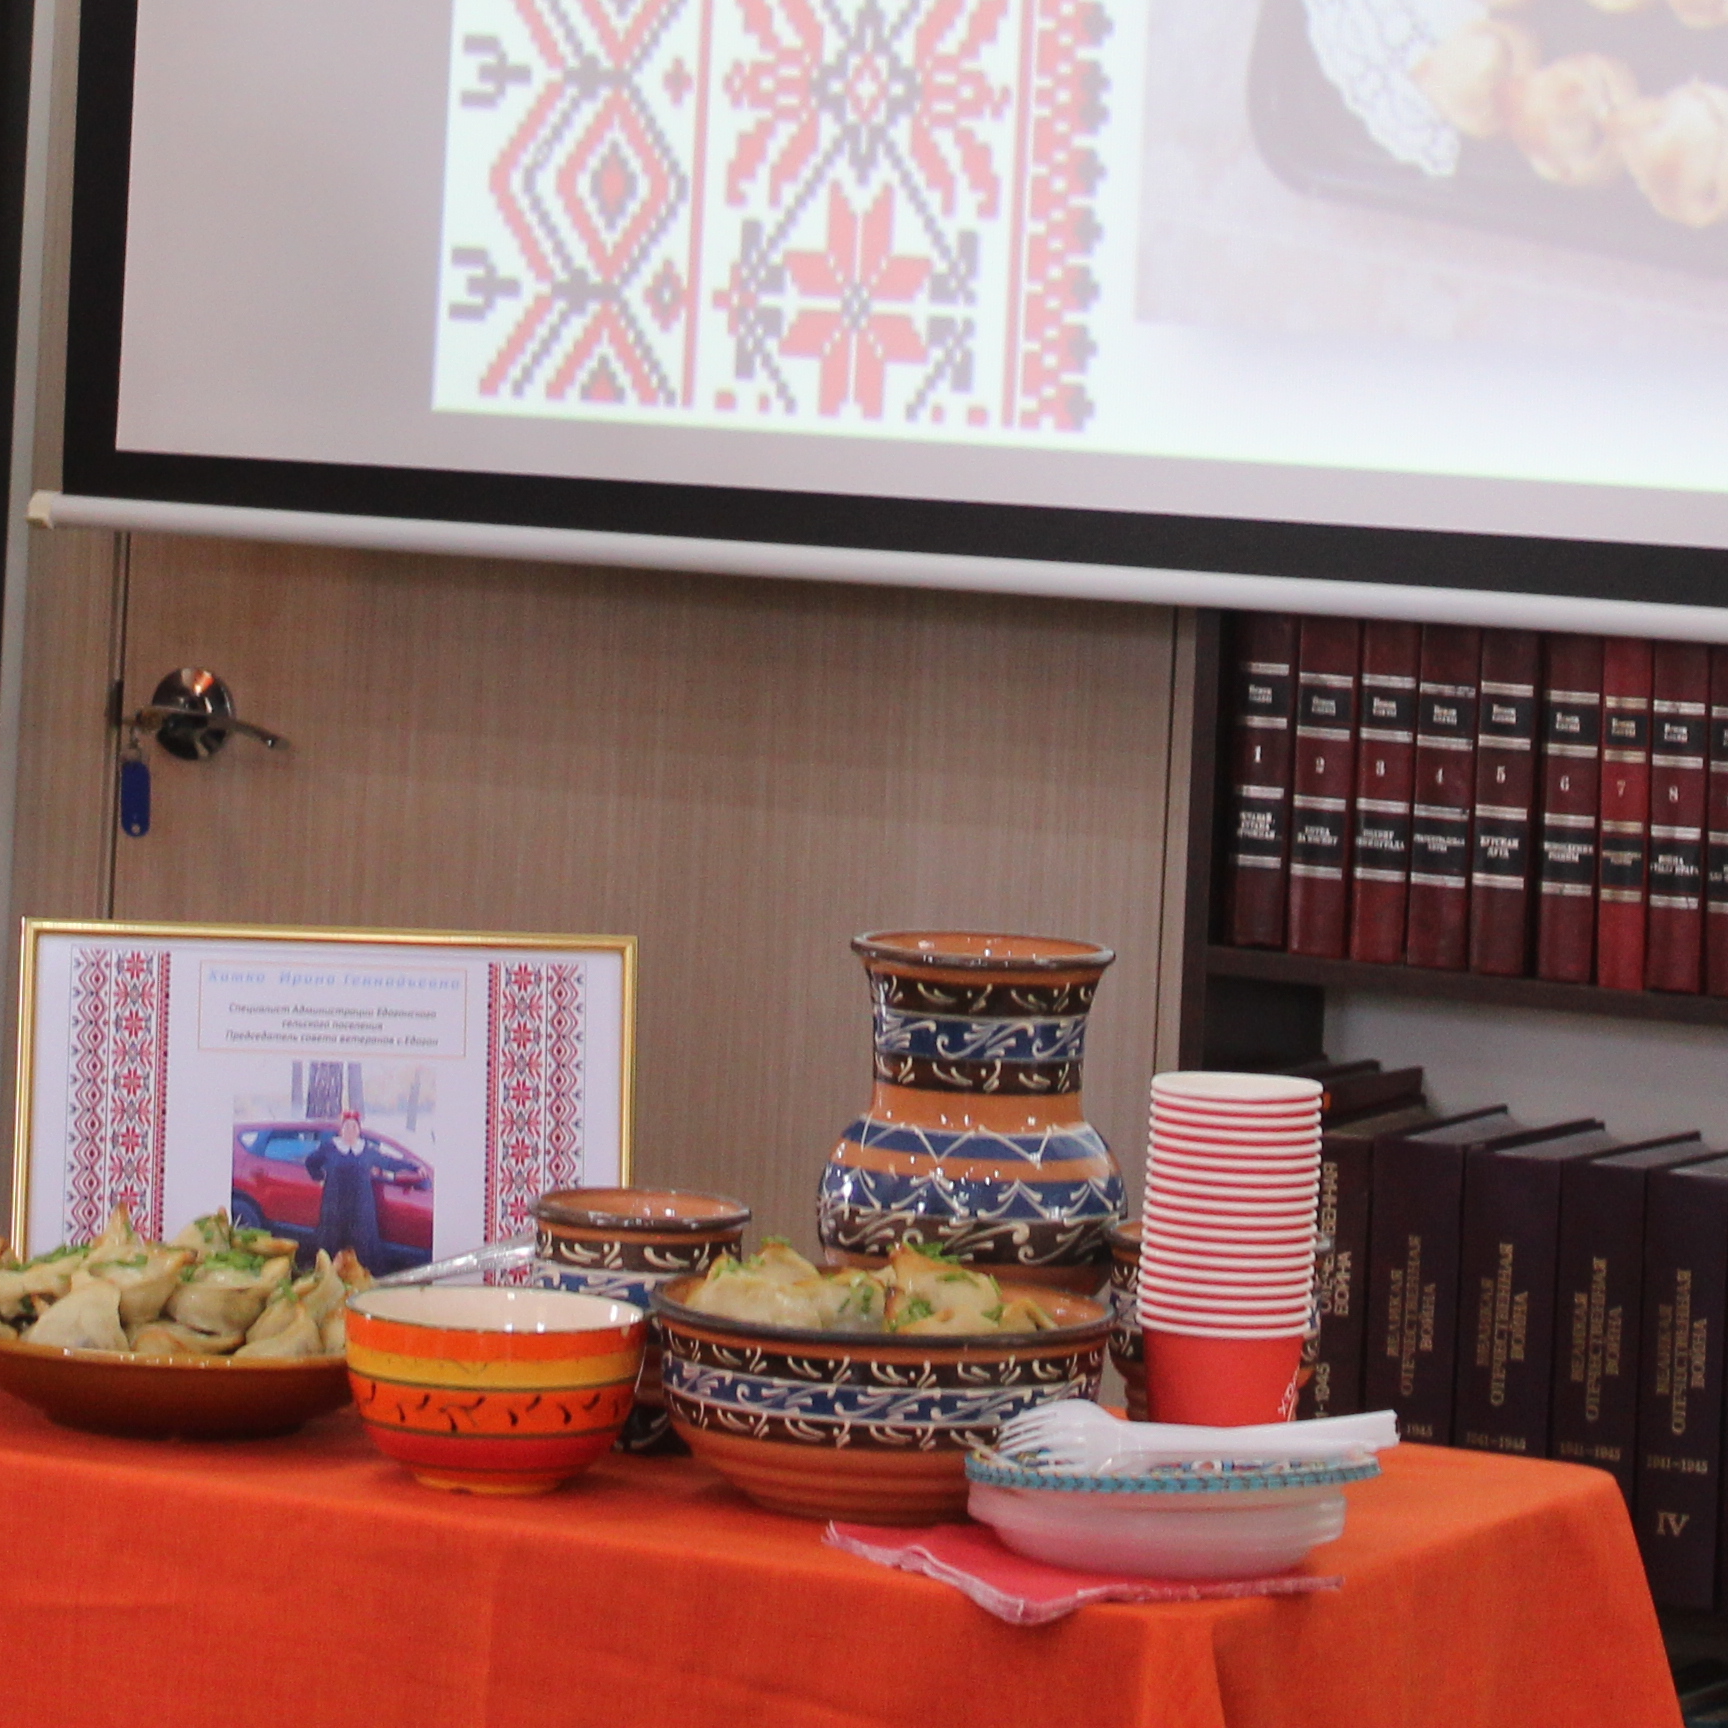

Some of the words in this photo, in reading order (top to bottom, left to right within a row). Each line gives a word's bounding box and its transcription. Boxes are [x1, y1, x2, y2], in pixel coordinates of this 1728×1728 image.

[1254, 744, 1262, 763] 1
[1315, 756, 1325, 774] 2
[1375, 759, 1386, 777] 3
[1495, 765, 1506, 784] 5
[1559, 775, 1570, 792] 6
[1616, 779, 1626, 798] 7
[1668, 785, 1679, 803] 8
[228, 1002, 290, 1017] Специалист
[278, 969, 336, 988] Ирина
[225, 1029, 298, 1044] Председатель
[1333, 1251, 1352, 1318] ВОЙНА
[1386, 1269, 1404, 1358] ВЕЛИКАЯ
[1400, 1234, 1422, 1397] ОТЕЧЕСТВЕННАЯ
[1419, 1282, 1437, 1352] ВОЙНА
[1477, 1276, 1495, 1367] ВЕЛИКАЯ
[1490, 1243, 1514, 1407] ОТЕЧЕСТВЕННАЯ
[1510, 1290, 1529, 1362] ВОЙНА
[1571, 1291, 1588, 1384] ВЕЛИКАЯ
[1585, 1256, 1608, 1422] ОТЕЧЕСТВЕННАЯ
[1605, 1305, 1623, 1376] ВОЙНА
[1656, 1304, 1674, 1396] ВЕЛИКАЯ
[1670, 1269, 1693, 1436] ОТЕЧЕСТВЕННАЯ
[1690, 1317, 1708, 1389] ВОЙНА
[1656, 1510, 1689, 1538] IV
